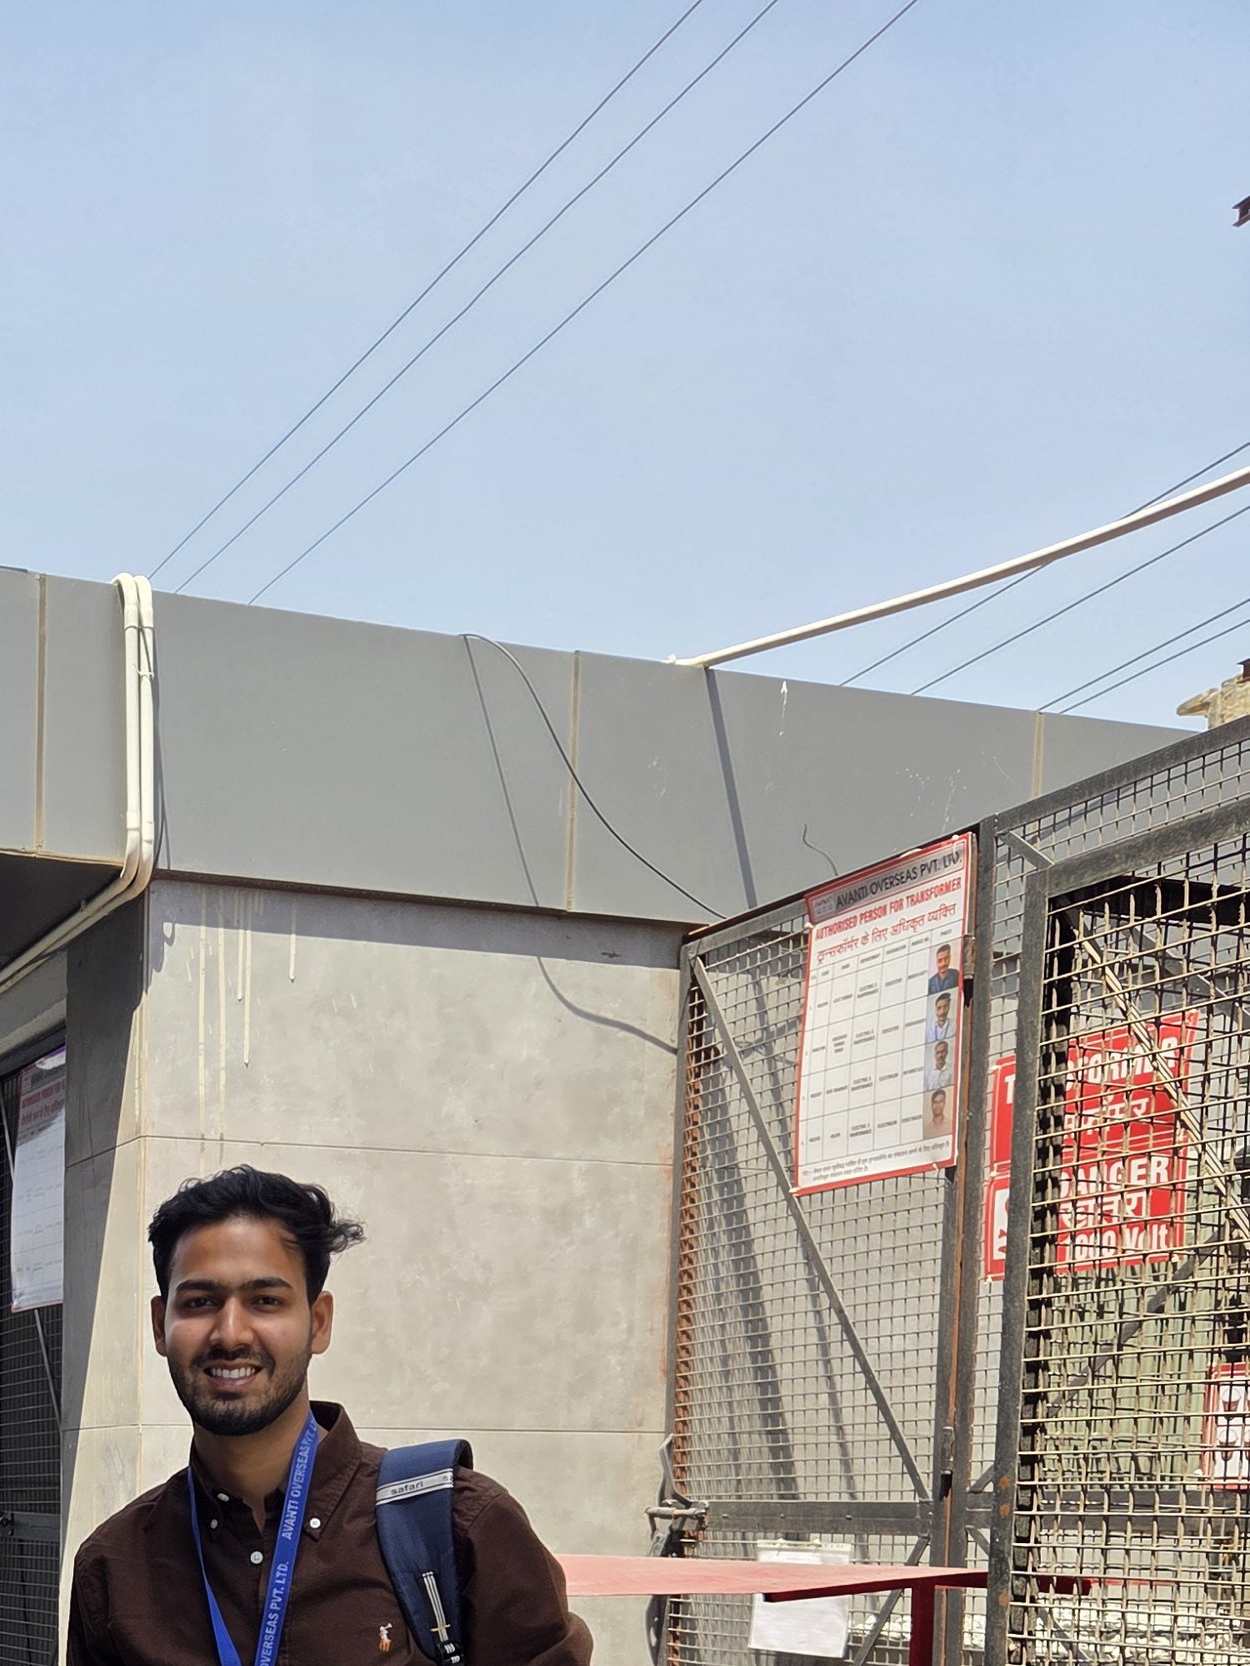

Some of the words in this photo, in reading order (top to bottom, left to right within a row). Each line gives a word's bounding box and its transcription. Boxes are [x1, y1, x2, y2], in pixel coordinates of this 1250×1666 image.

[836, 886, 868, 912] AVANTI
[870, 868, 918, 896] OVERSEAS
[920, 861, 940, 877] PVT.
[815, 915, 857, 940] AUTHORISED
[859, 905, 887, 925] PERSON
[889, 898, 904, 914] FOR
[906, 876, 962, 908] TRANSFORMER
[281, 1499, 300, 1540] AVANTI
[291, 1443, 309, 1499] OVERSEAS
[390, 1481, 424, 1496] safari
[274, 1561, 290, 1586] LTD.
[270, 1585, 285, 1611] PVT.
